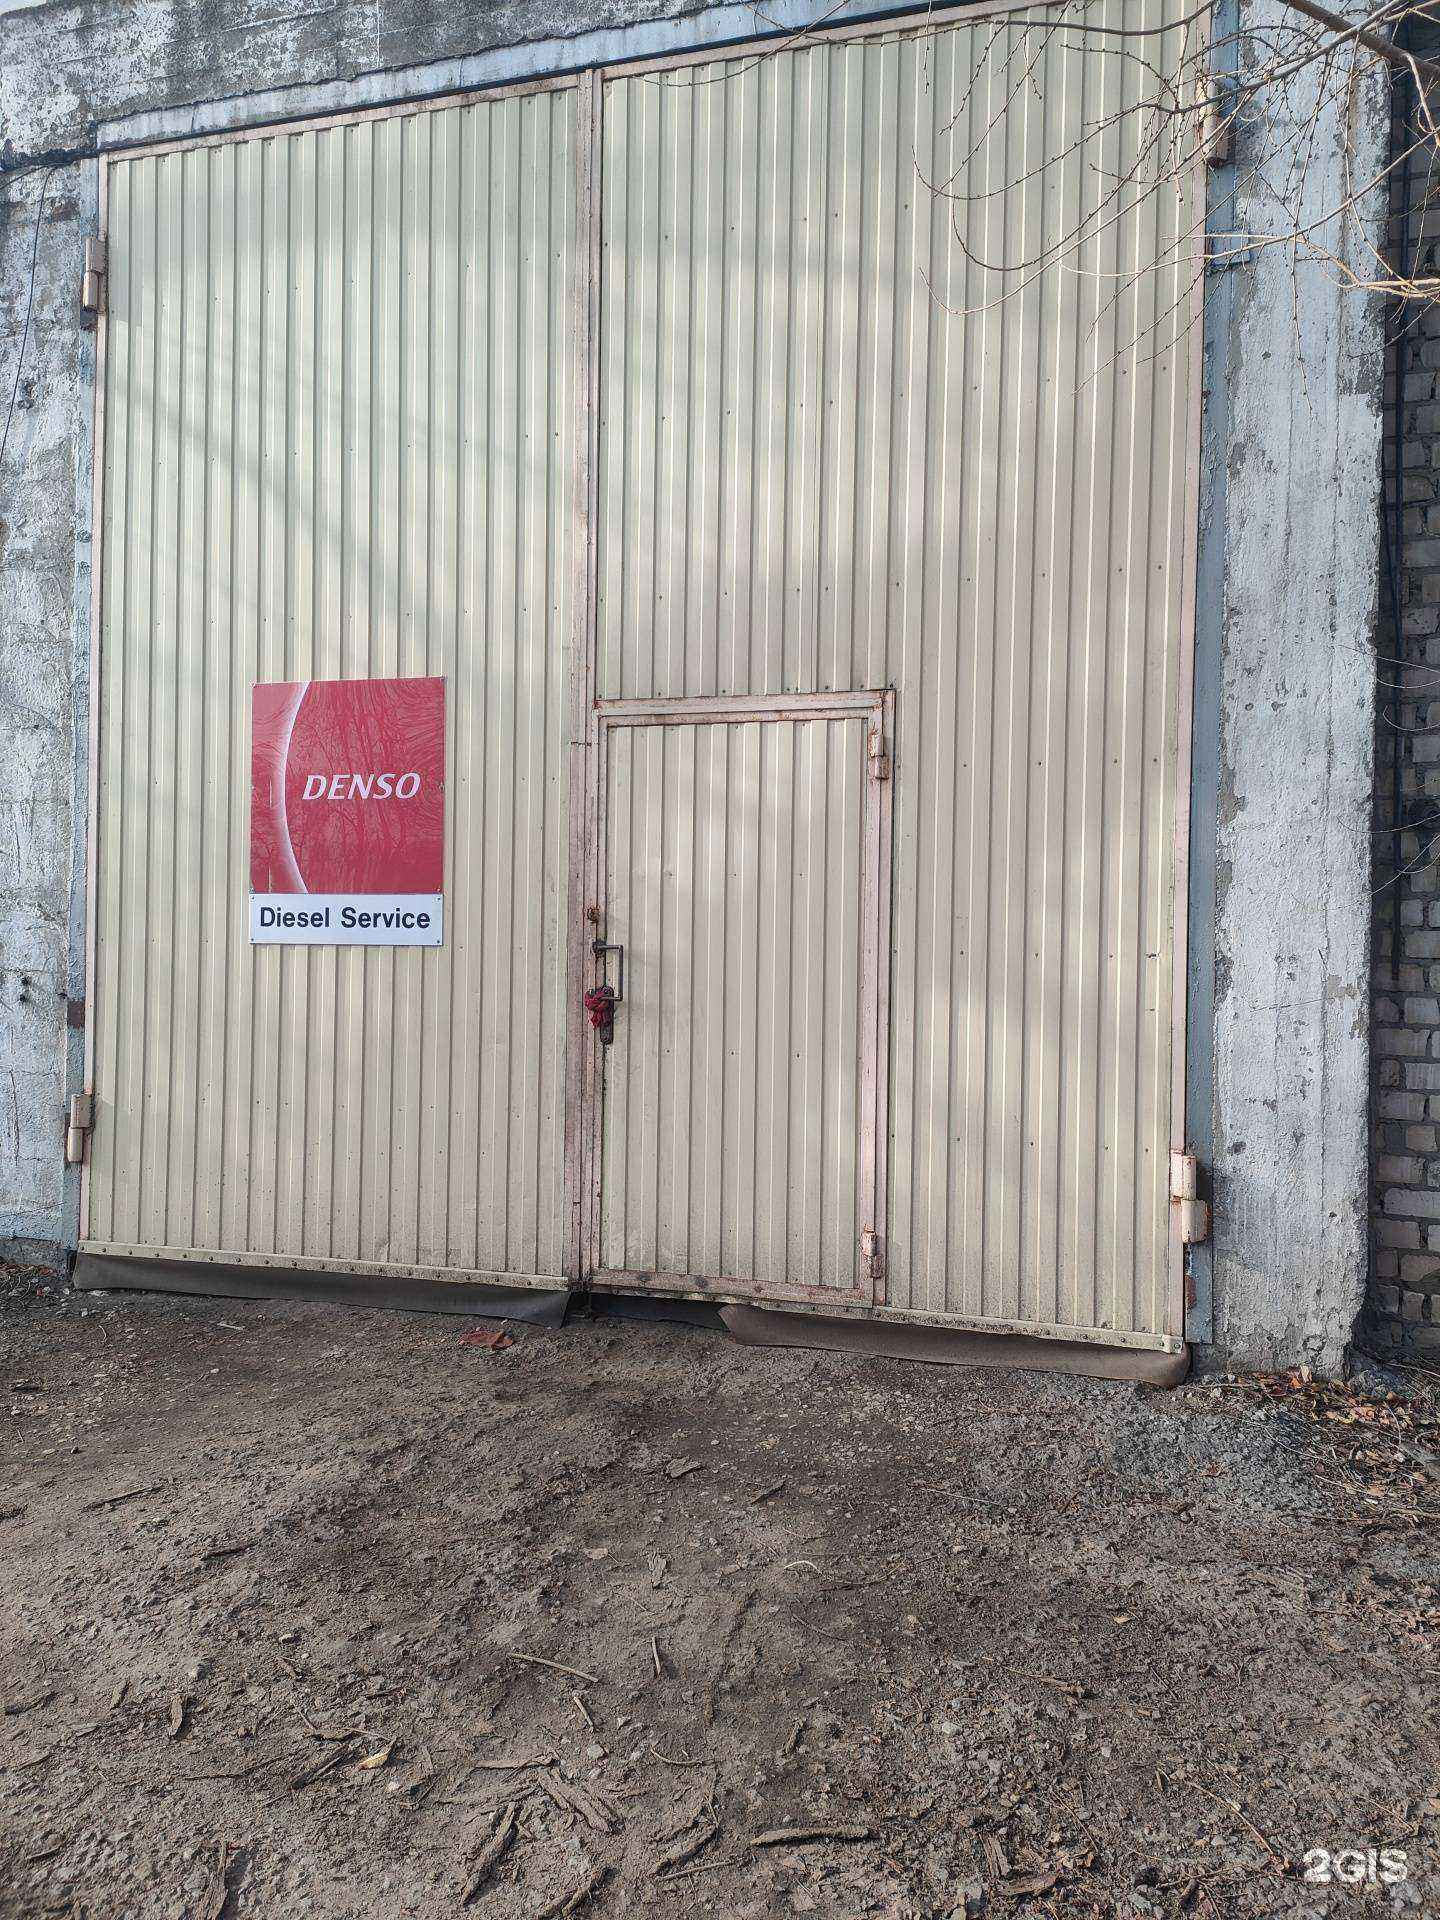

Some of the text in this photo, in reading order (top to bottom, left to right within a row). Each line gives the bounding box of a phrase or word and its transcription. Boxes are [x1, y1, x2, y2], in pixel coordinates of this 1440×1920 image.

[302, 772, 421, 801] DENSO
[260, 906, 431, 929] Diesel Service
